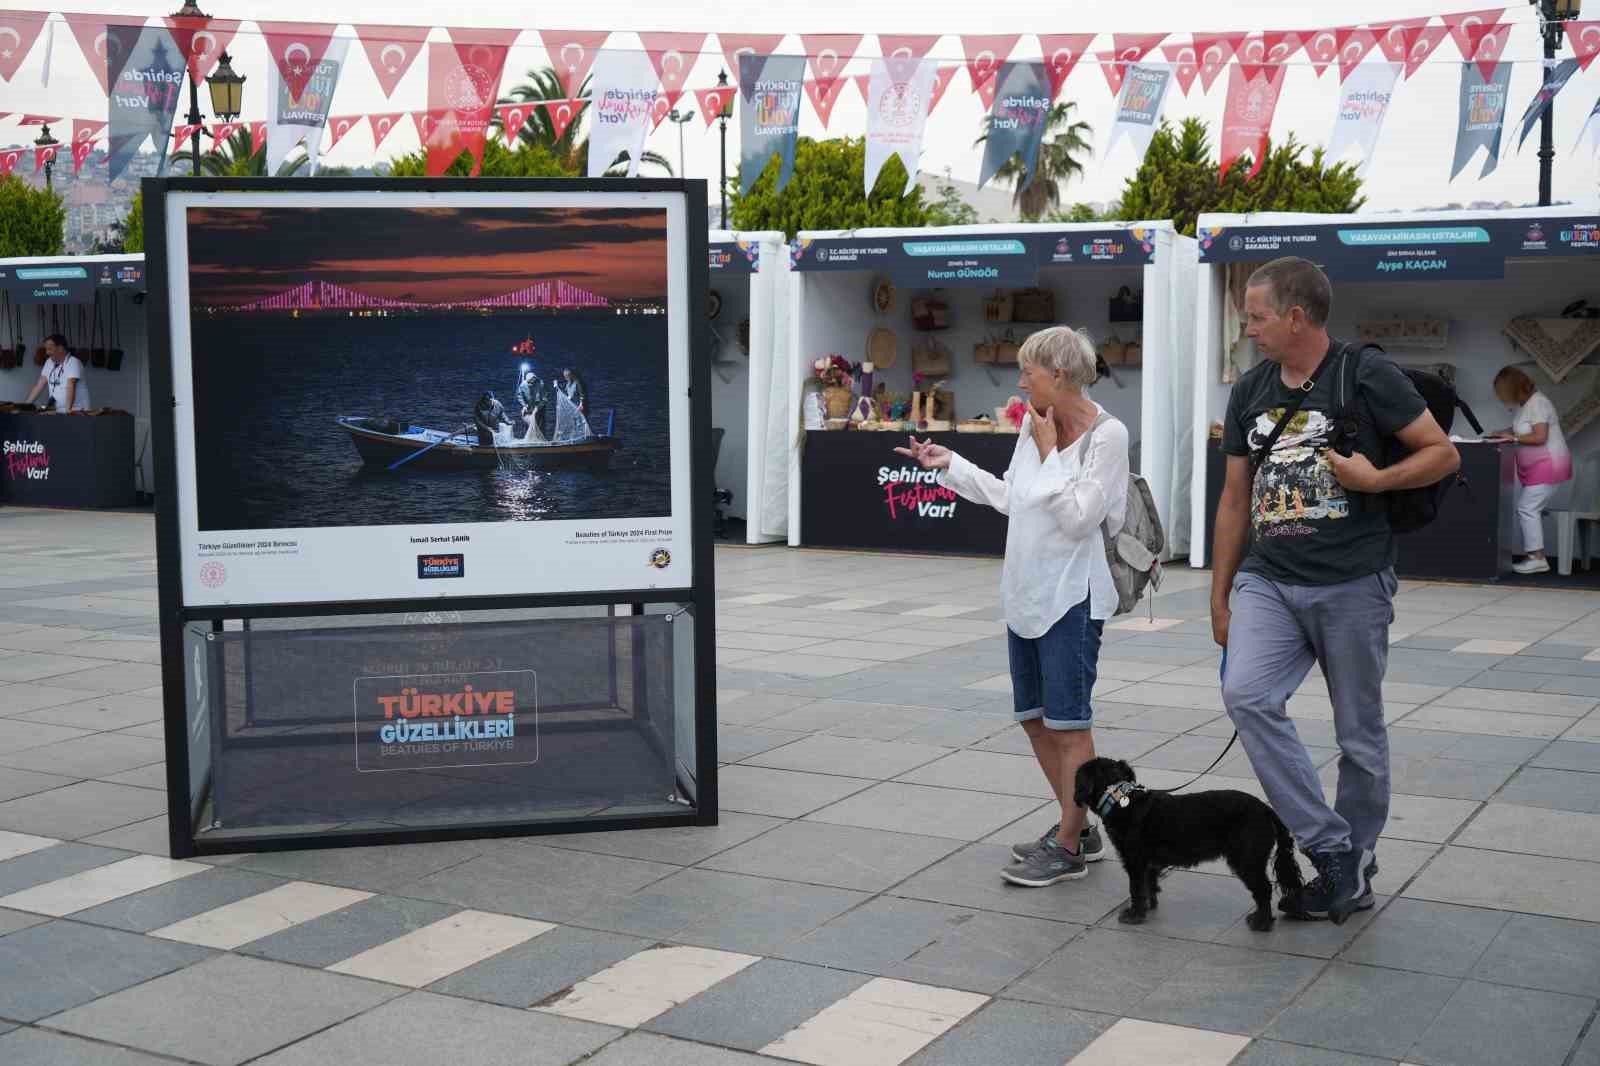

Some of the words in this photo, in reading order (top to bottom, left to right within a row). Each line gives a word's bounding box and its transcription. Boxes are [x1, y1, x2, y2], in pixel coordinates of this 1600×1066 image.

[1376, 261, 1404, 272] Ayşe
[1404, 259, 1447, 271] KAÇAN
[3, 440, 44, 454] Şehirde
[27, 467, 49, 480] Var!
[917, 502, 957, 518] Var!
[377, 684, 515, 719] TÜRKİYE
[380, 712, 514, 744] GÜZELLİKLERİ
